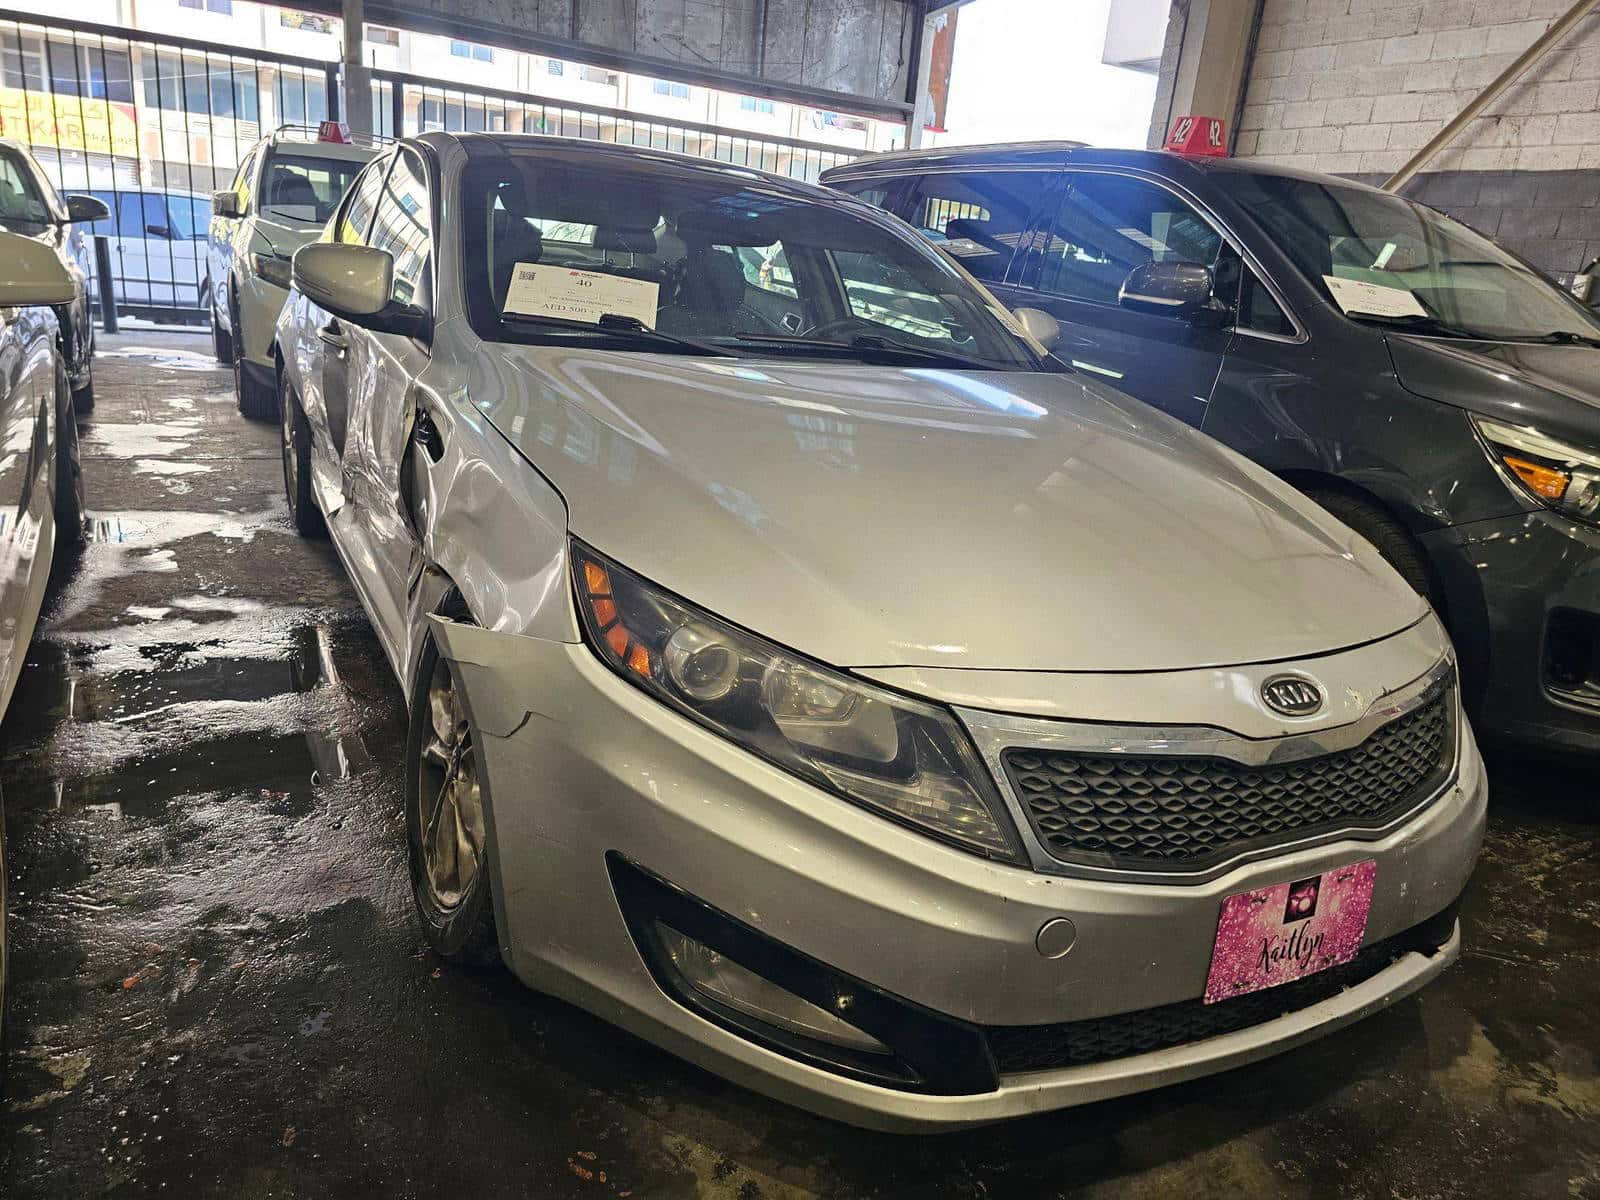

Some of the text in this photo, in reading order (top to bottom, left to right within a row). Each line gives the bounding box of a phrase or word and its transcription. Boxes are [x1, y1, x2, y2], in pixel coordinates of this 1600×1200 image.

[1174, 119, 1192, 143] 42
[1210, 121, 1222, 146] 42
[1271, 683, 1318, 705] KIA
[1256, 920, 1324, 973] Kaitlyn
